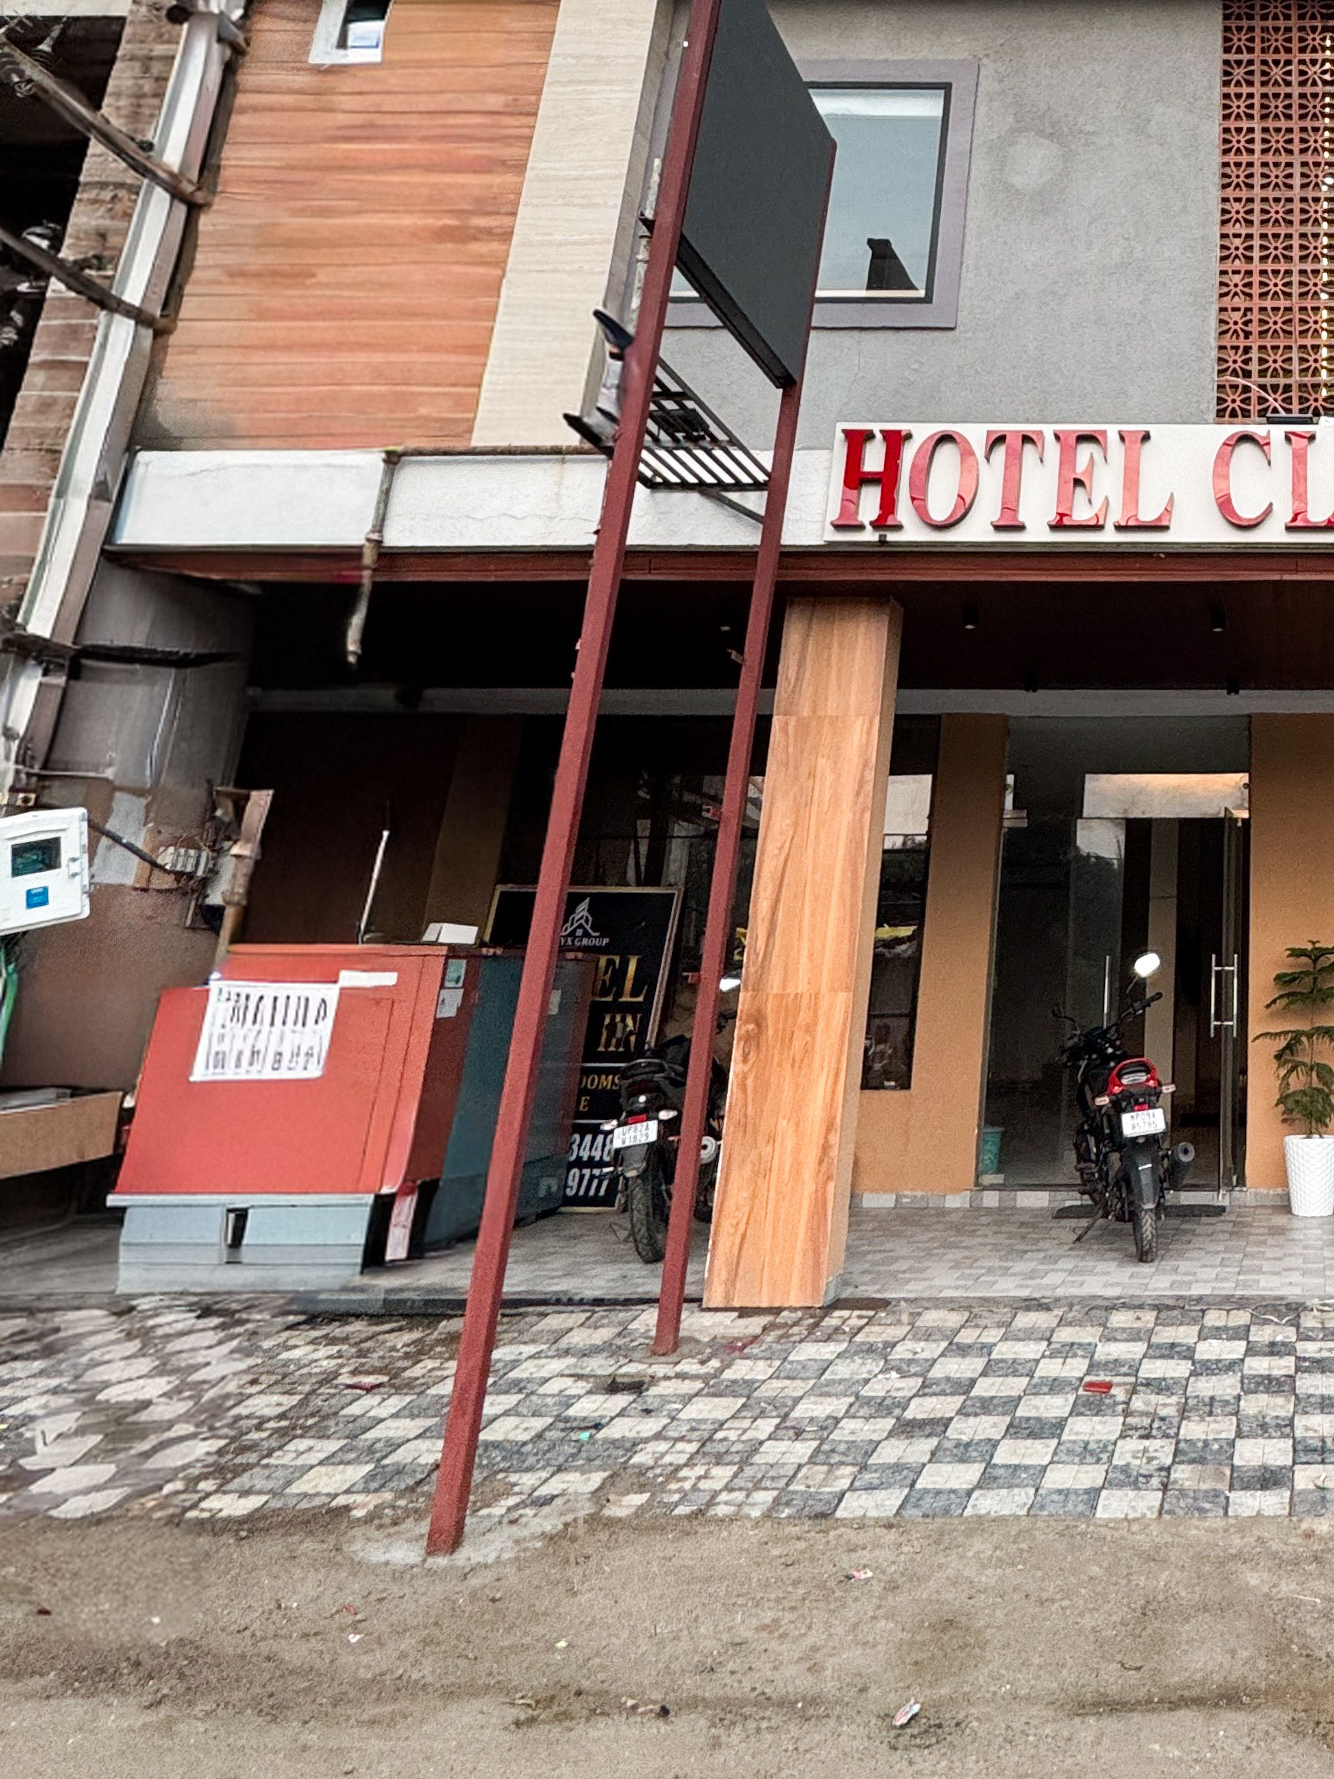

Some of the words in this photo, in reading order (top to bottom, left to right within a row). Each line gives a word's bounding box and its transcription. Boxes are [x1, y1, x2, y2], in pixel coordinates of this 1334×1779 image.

[828, 427, 1173, 532] HOTEL
[560, 936, 574, 946] YX
[574, 937, 610, 947] GROUP
[580, 1074, 620, 1090] OMS
